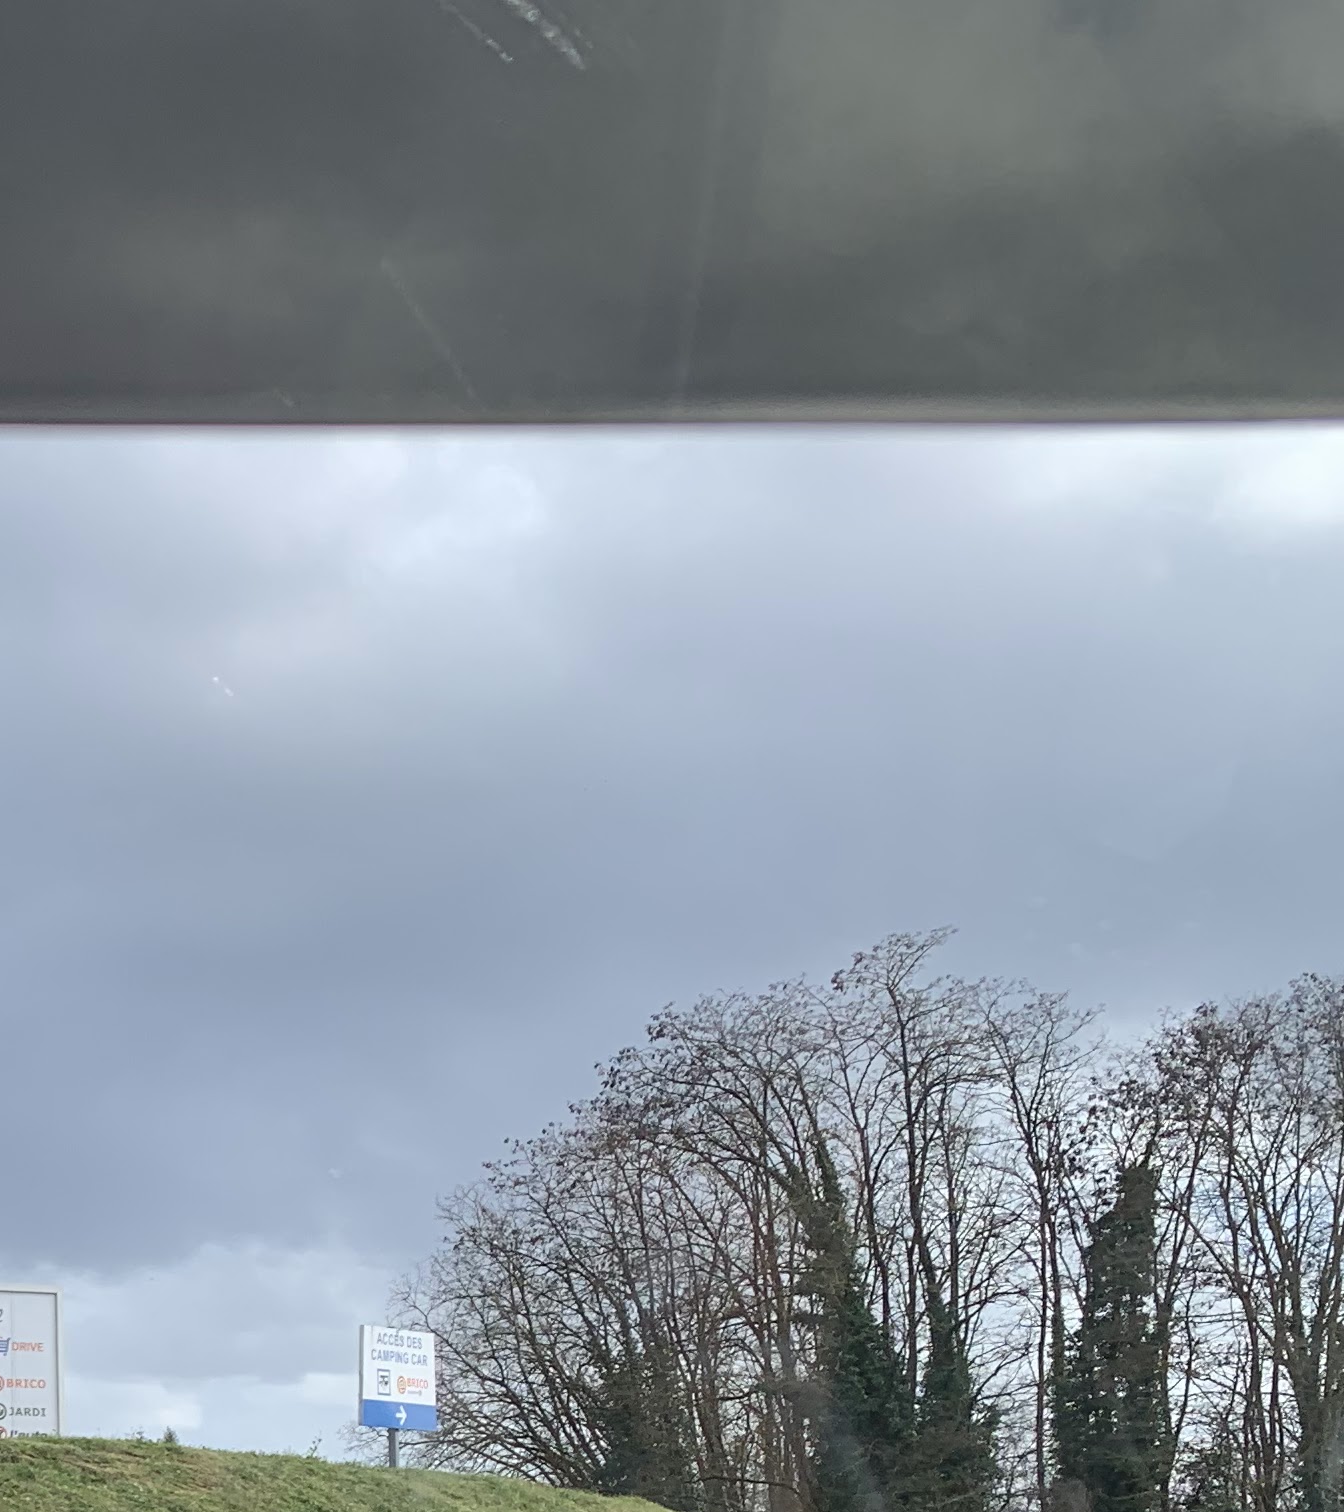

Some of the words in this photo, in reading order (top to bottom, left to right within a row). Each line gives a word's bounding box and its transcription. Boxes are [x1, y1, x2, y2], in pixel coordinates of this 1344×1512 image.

[12, 1341, 44, 1352] DRIVE
[406, 1335, 423, 1350] DES
[371, 1348, 409, 1366] CAMPING
[411, 1353, 428, 1367] CAR
[6, 1378, 47, 1389] BRICO
[407, 1378, 429, 1390] BRICO
[9, 1406, 47, 1417] JARDI
